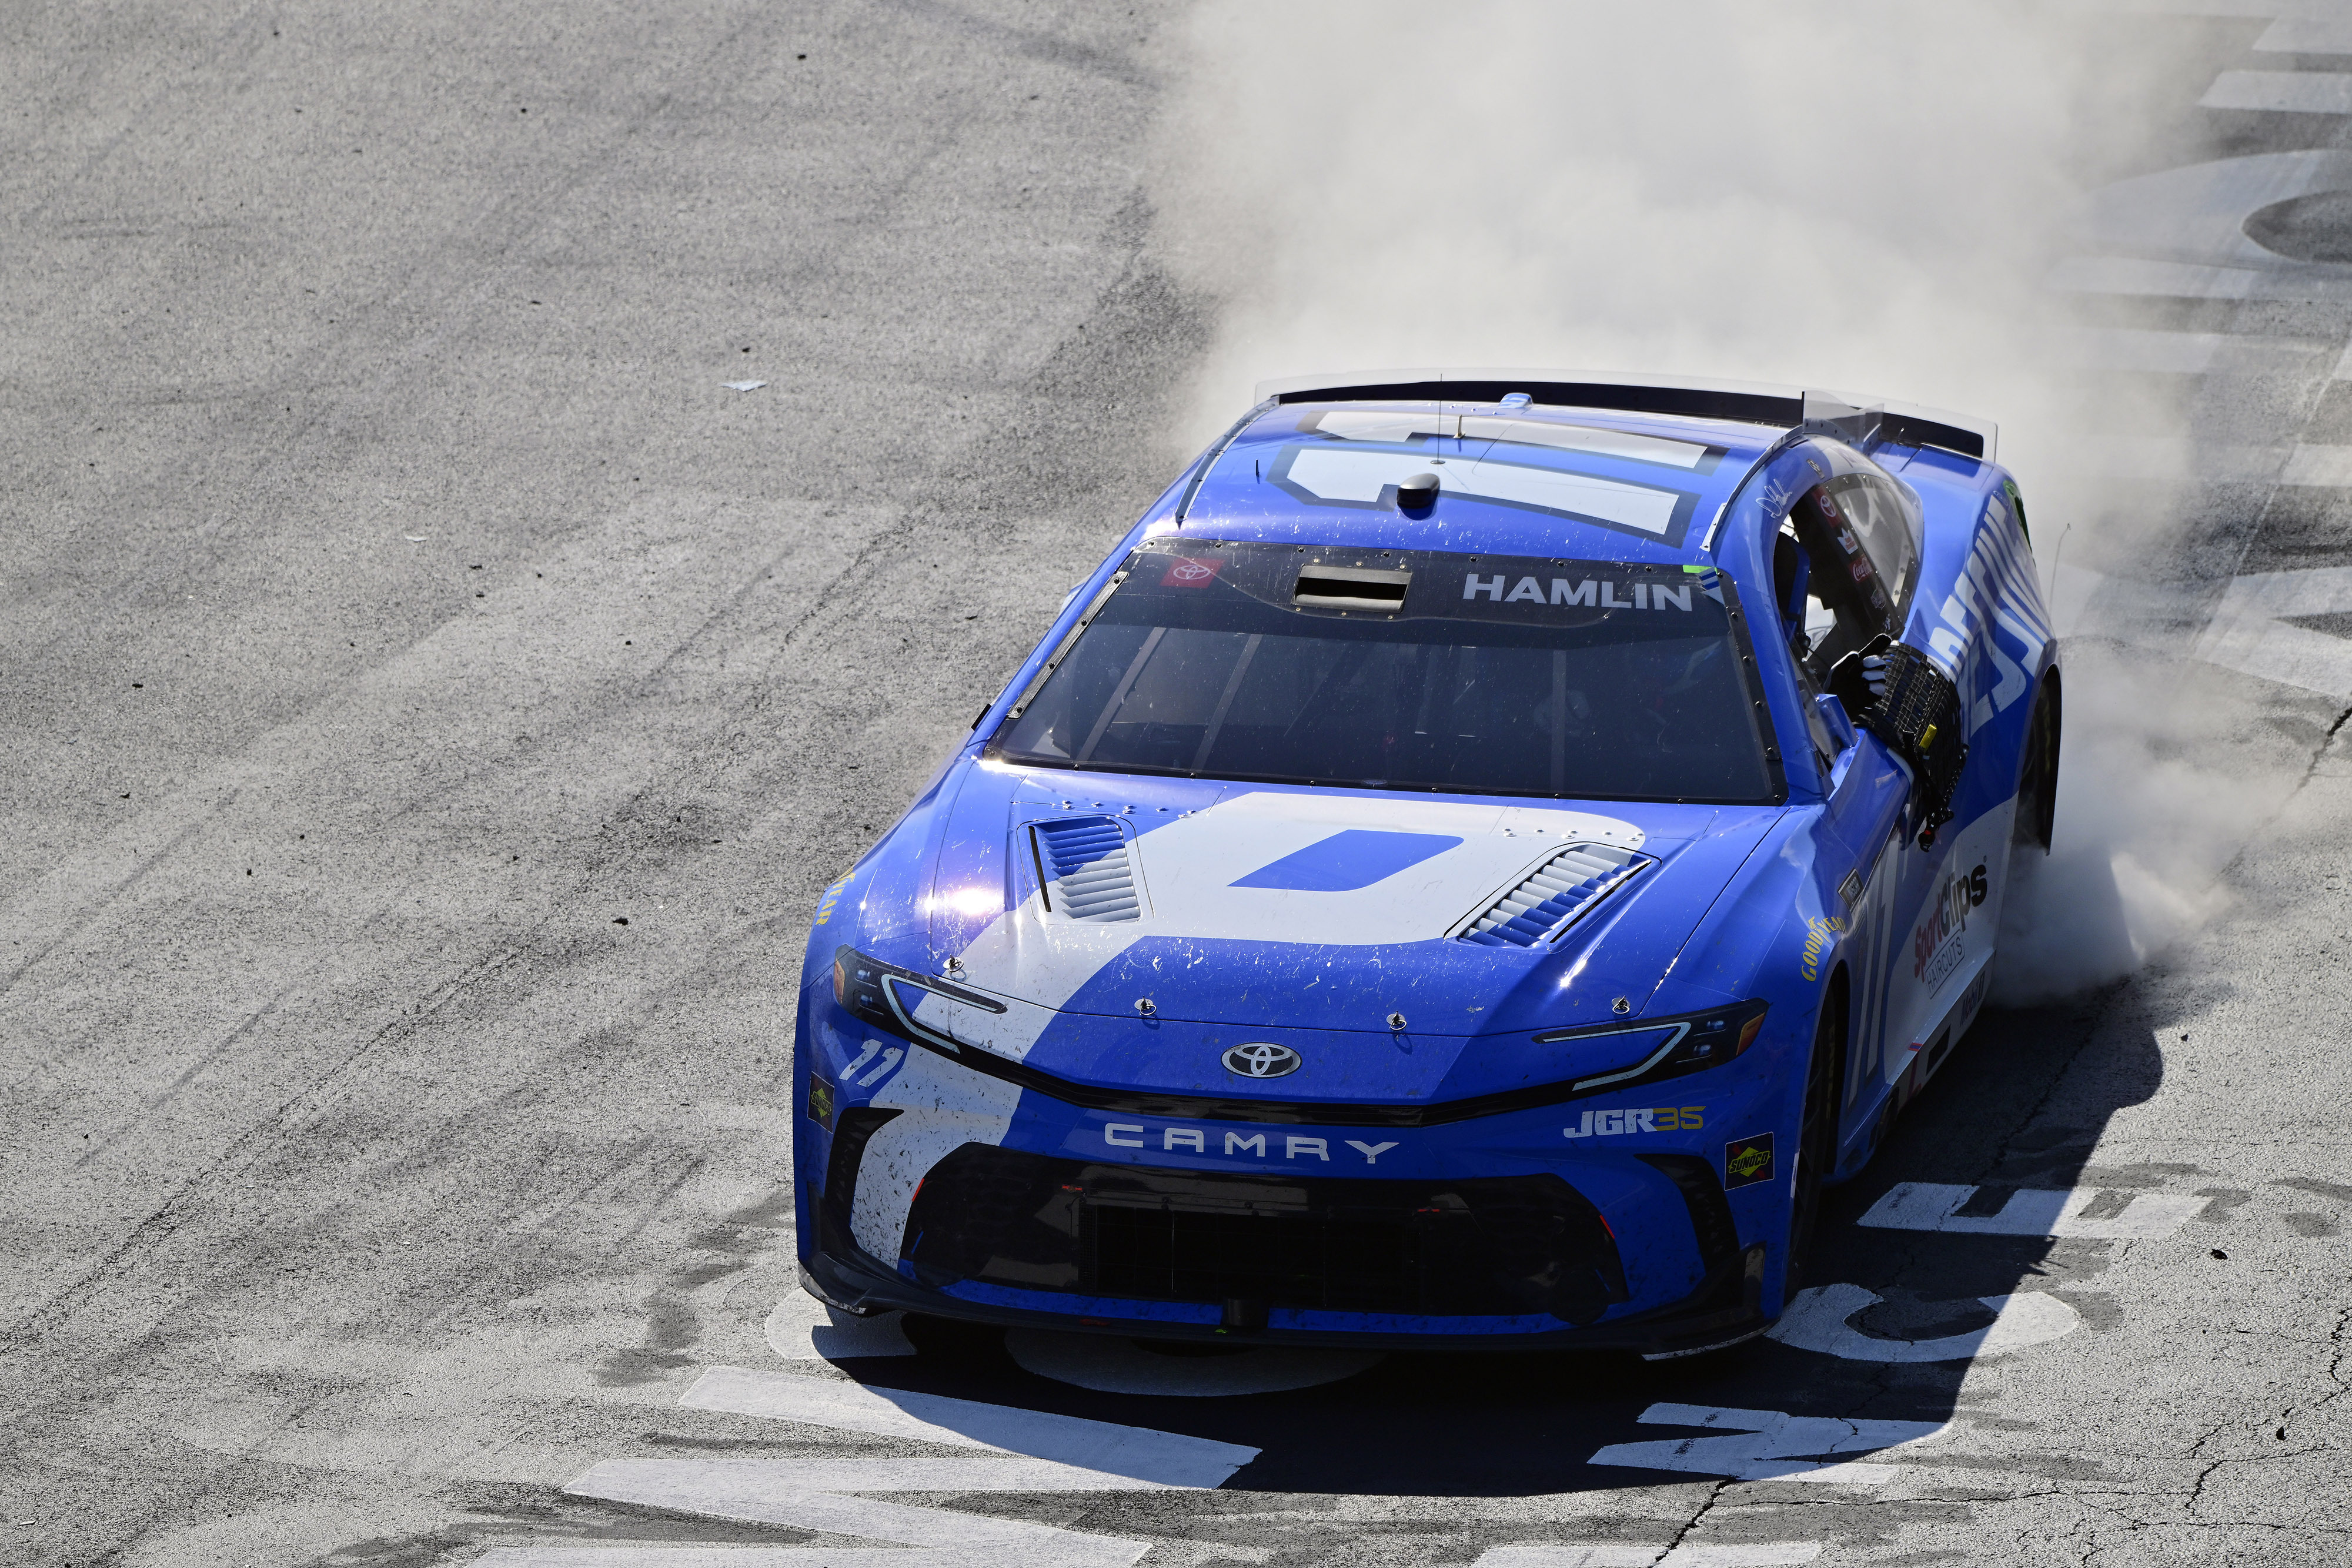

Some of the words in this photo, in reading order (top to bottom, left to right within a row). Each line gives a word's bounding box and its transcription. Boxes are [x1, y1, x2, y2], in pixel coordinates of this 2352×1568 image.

[1462, 573, 1693, 612] HAMLIN
[1801, 915, 1846, 982] GOODYEAR
[1926, 936, 1963, 994] HAIRCUTS
[838, 1038, 904, 1088] 11
[811, 1092, 832, 1113] SUNOCO
[1104, 1122, 1400, 1164] CAMRY
[1729, 1149, 1769, 1172] SUNOCO
